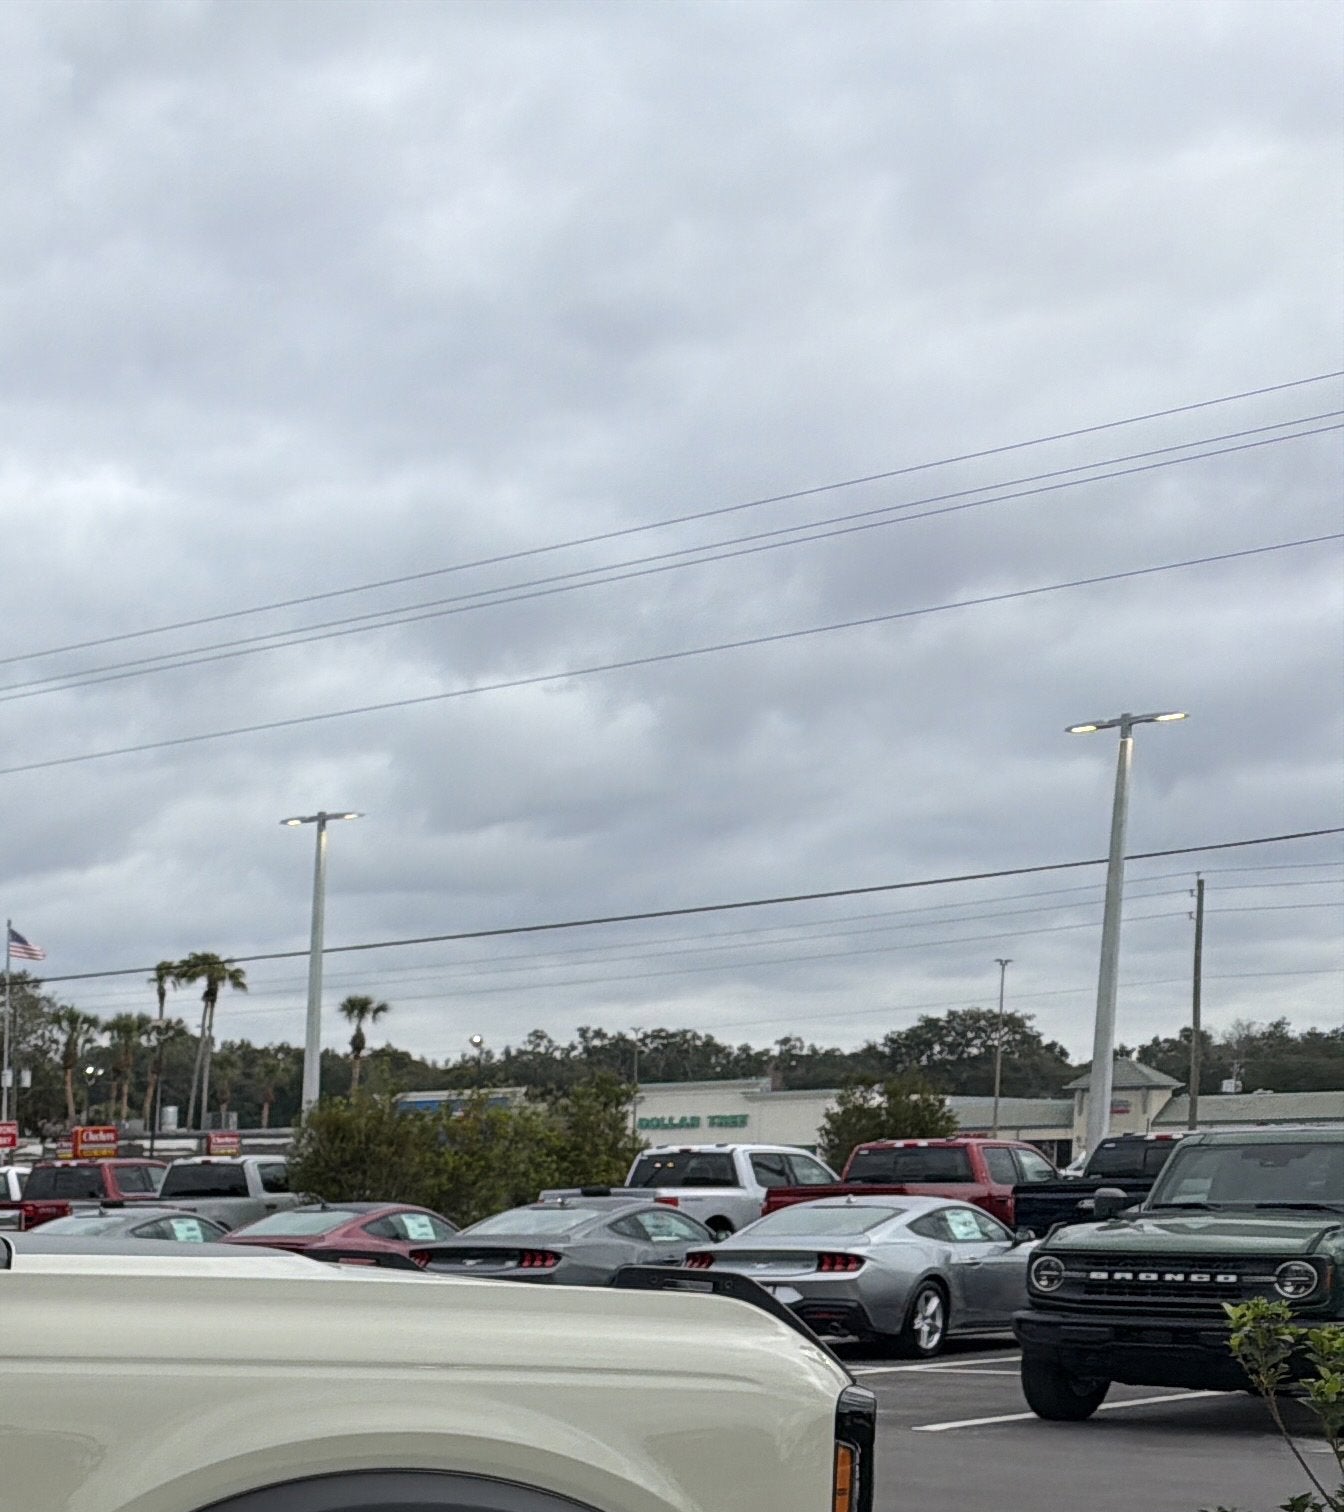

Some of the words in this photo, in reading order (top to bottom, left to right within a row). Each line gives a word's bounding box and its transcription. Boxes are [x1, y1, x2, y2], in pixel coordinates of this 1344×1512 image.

[638, 1116, 700, 1129] DOLLAR
[707, 1114, 749, 1128] TREE
[1089, 1271, 1238, 1283] BRONCO
